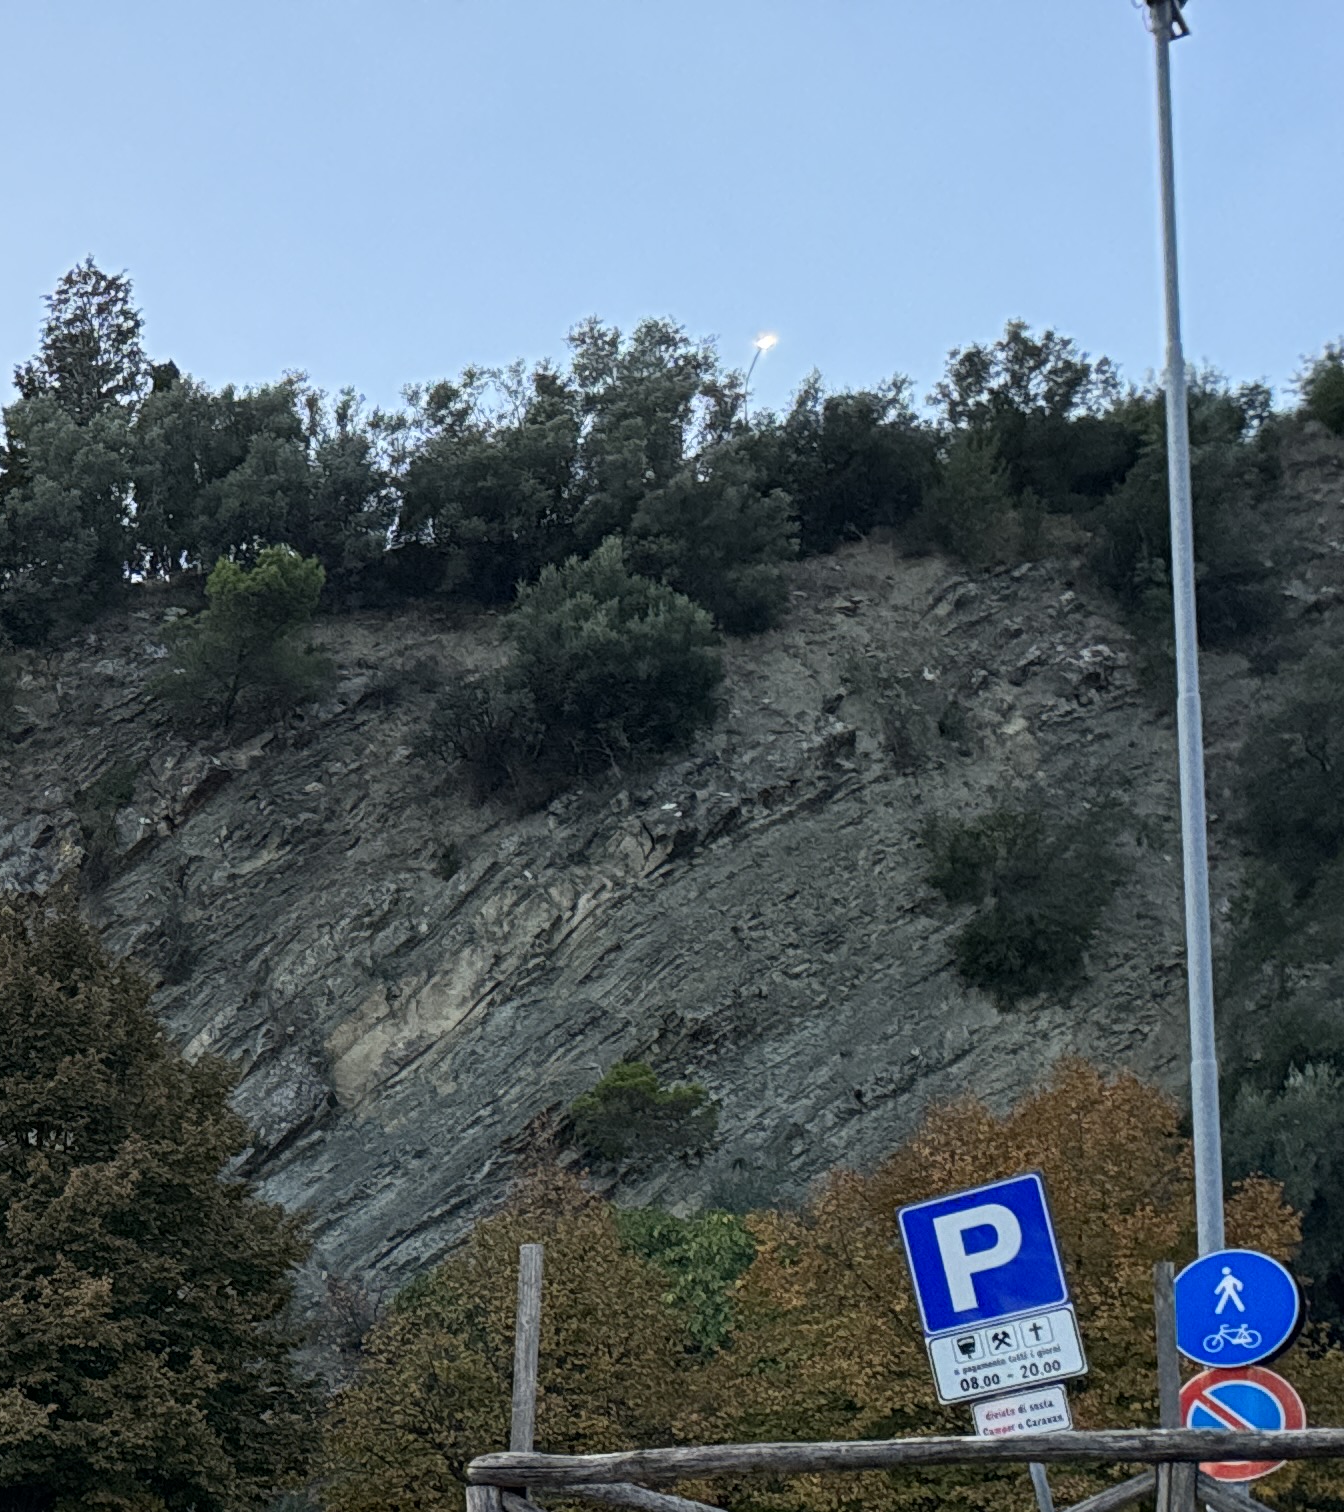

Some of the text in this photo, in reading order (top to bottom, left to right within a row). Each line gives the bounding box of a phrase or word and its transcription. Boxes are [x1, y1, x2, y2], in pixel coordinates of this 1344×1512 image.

[933, 1203, 1022, 1313] P
[960, 1373, 1000, 1392] 08.00
[1020, 1360, 1061, 1379] 20.00
[962, 1358, 1006, 1376] pagamento
[1008, 1352, 1028, 1363] tutti
[1037, 1344, 1062, 1358] giorni
[985, 1400, 1054, 1421] divieto di sosta
[1026, 1414, 1064, 1428] Caravan
